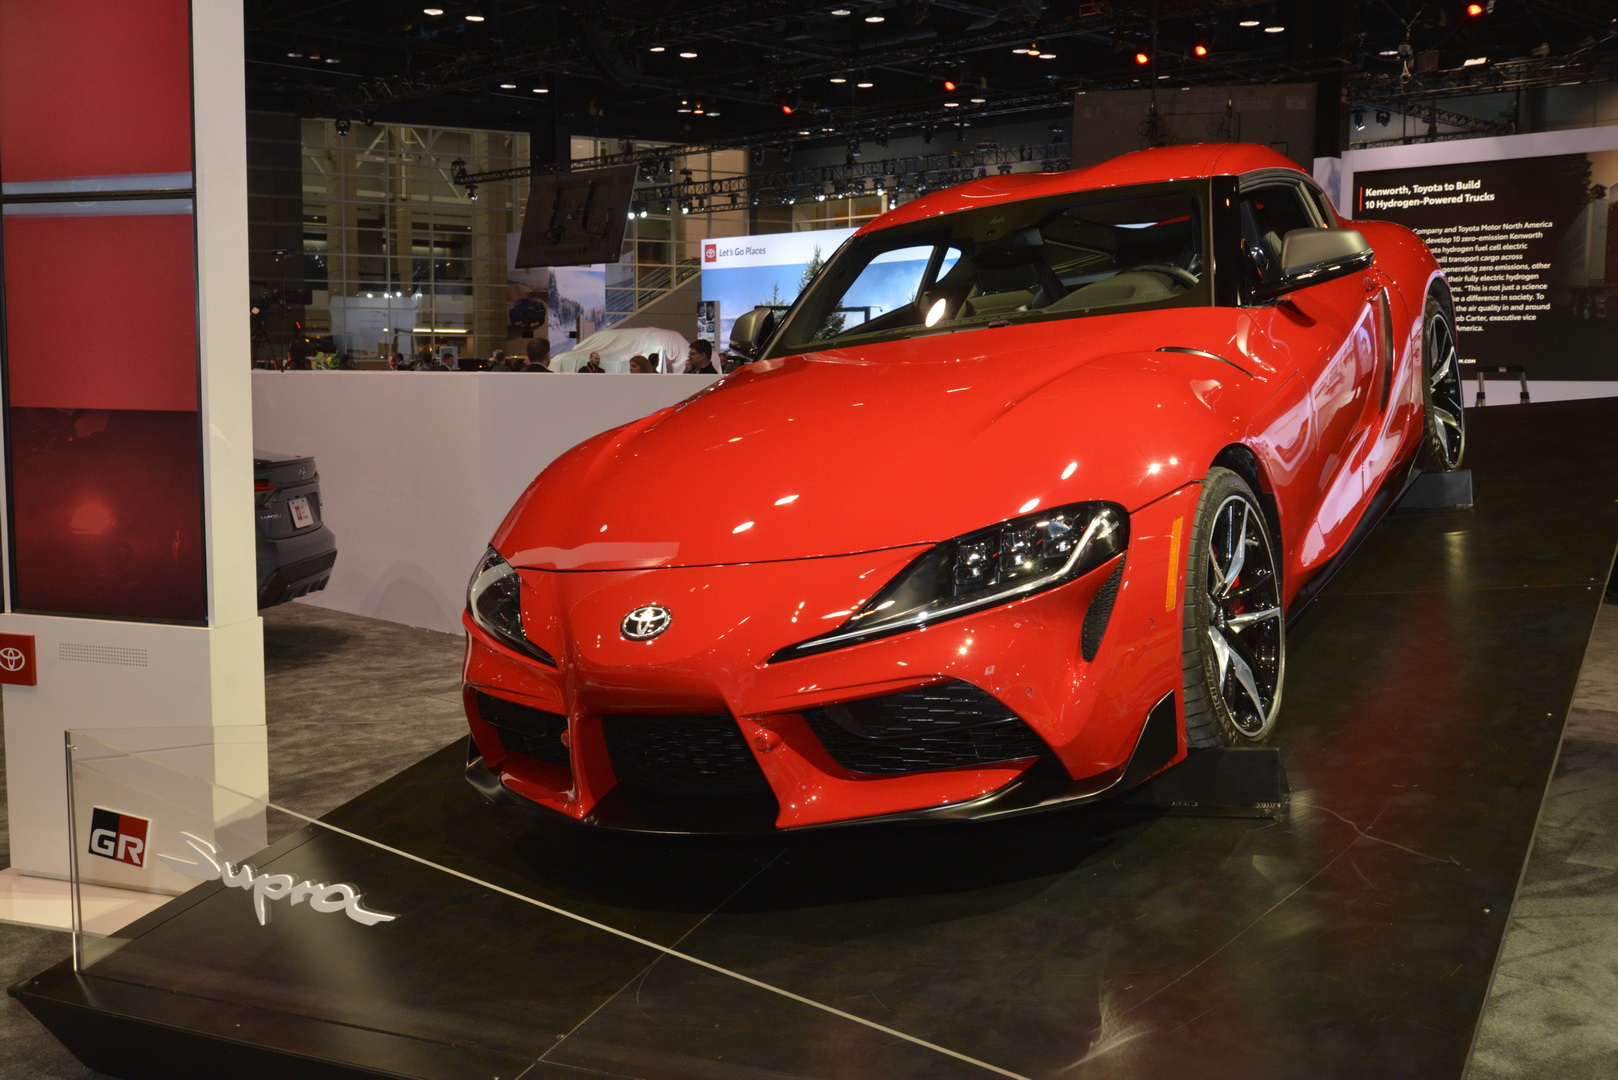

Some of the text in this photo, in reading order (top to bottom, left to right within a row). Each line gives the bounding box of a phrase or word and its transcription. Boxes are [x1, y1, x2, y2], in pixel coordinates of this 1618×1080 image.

[1365, 180, 1481, 197] Kenworth, Toyota to Build
[1365, 192, 1495, 210] 10 Hydrogen-Powered Trucks
[1413, 226, 1443, 235] Company
[1444, 226, 1457, 234] and
[1458, 225, 1480, 233] Toyota
[1481, 223, 1501, 232] Motor
[1502, 222, 1523, 230] North
[1426, 231, 1543, 245] develop 10 zero-emission Kenworth
[719, 246, 766, 257] Let's Go Places
[1442, 245, 1474, 255] hydrogen
[1475, 244, 1488, 252] fuel
[1489, 243, 1501, 251] cell
[1502, 242, 1528, 251] electric
[1449, 254, 1480, 263] transport
[1480, 254, 1500, 262] cargo
[1442, 265, 1477, 274] generating
[1494, 262, 1530, 271] emissions,
[1464, 274, 1479, 283] fully
[1480, 273, 1505, 281] electric
[1506, 273, 1539, 282] hydrogen
[1501, 283, 1515, 292] just
[1466, 294, 1500, 302] difference
[1509, 292, 1534, 301] society.
[1536, 292, 1544, 300] To
[1456, 304, 1467, 312] the
[1478, 303, 1501, 312] quality
[1466, 314, 1488, 322] Carter,
[1489, 313, 1521, 321] executive
[91, 828, 396, 926] GR Supra
